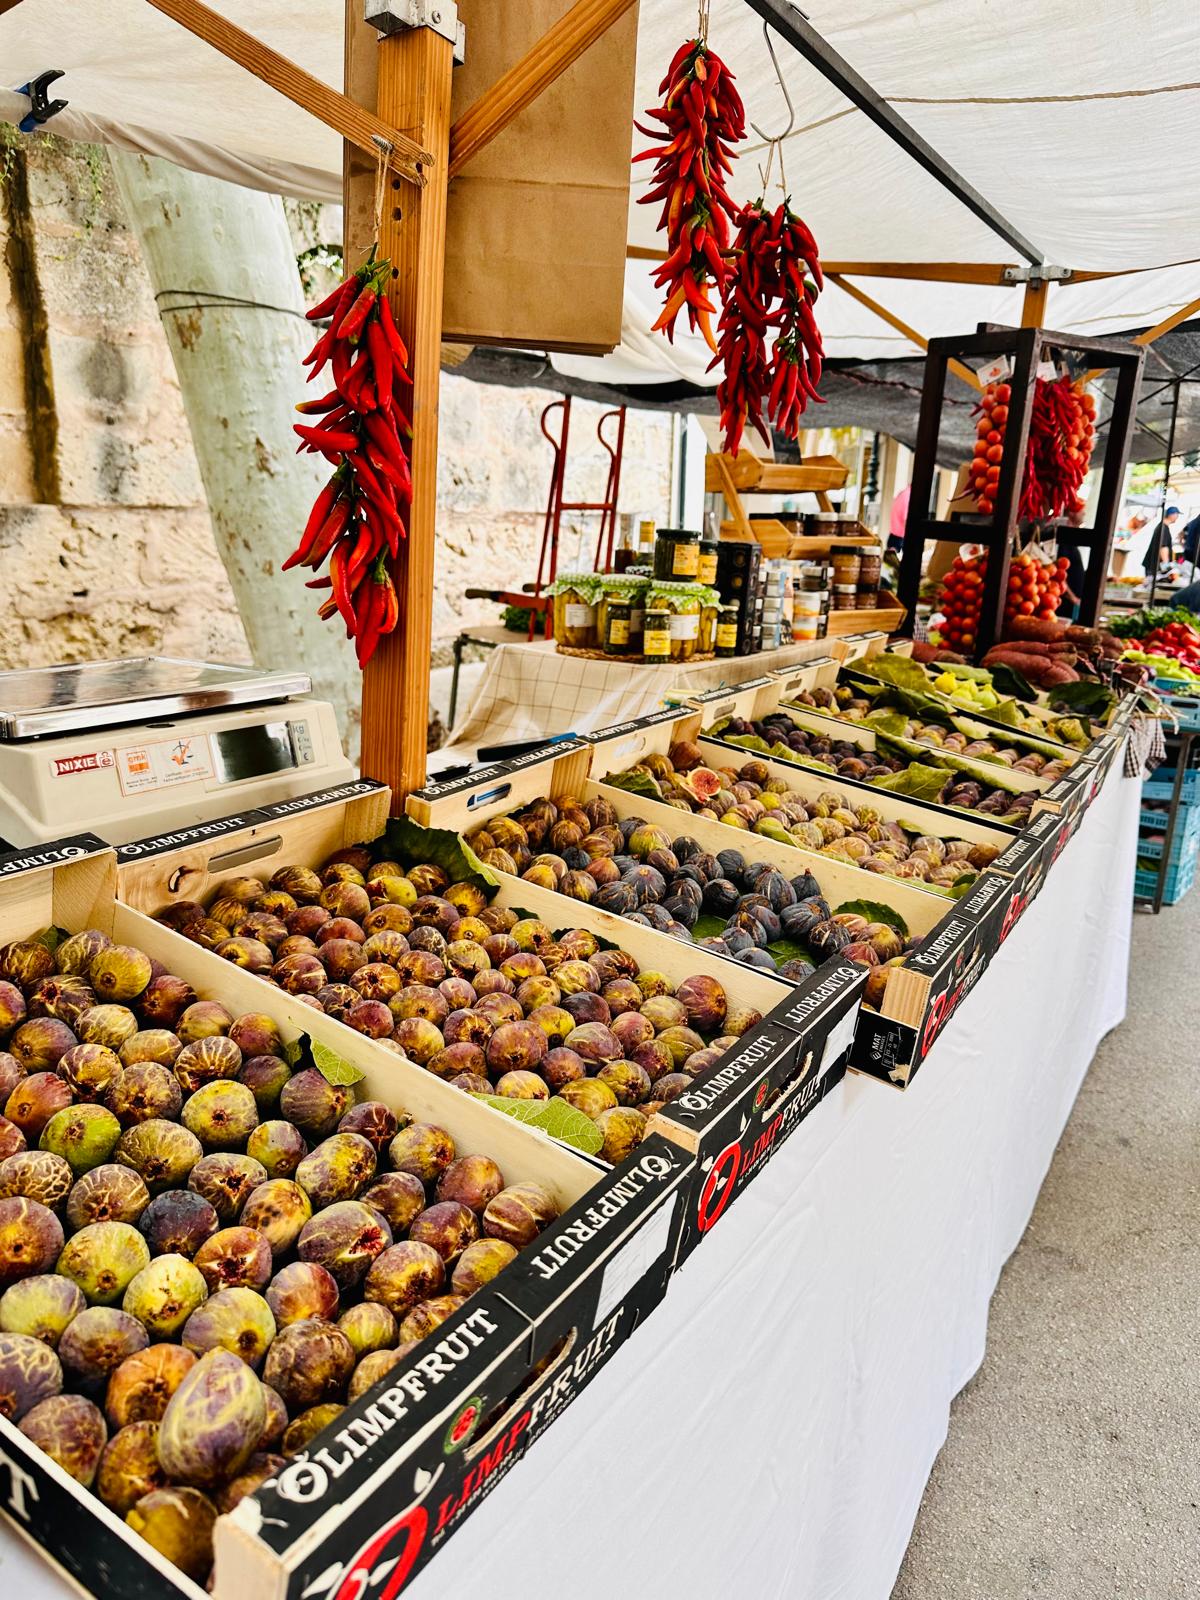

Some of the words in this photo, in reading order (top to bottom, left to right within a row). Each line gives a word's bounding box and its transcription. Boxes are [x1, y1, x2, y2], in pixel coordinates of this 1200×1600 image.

[58, 756, 95, 773] NIXIE
[422, 768, 500, 795] OLIMPFRUIT
[273, 783, 374, 814] OLIMPFRUIT
[117, 817, 246, 856] OLIMPFRUIT
[0, 847, 88, 874] OLIMP
[913, 920, 967, 966] OLIMPFRUIT
[785, 966, 860, 1023] OLIMPFRUIT
[677, 1034, 777, 1112] OLIMPFRUIT
[530, 1154, 674, 1280] OLIMPFRUIT
[270, 1308, 498, 1503] OLIMPFRUIT
